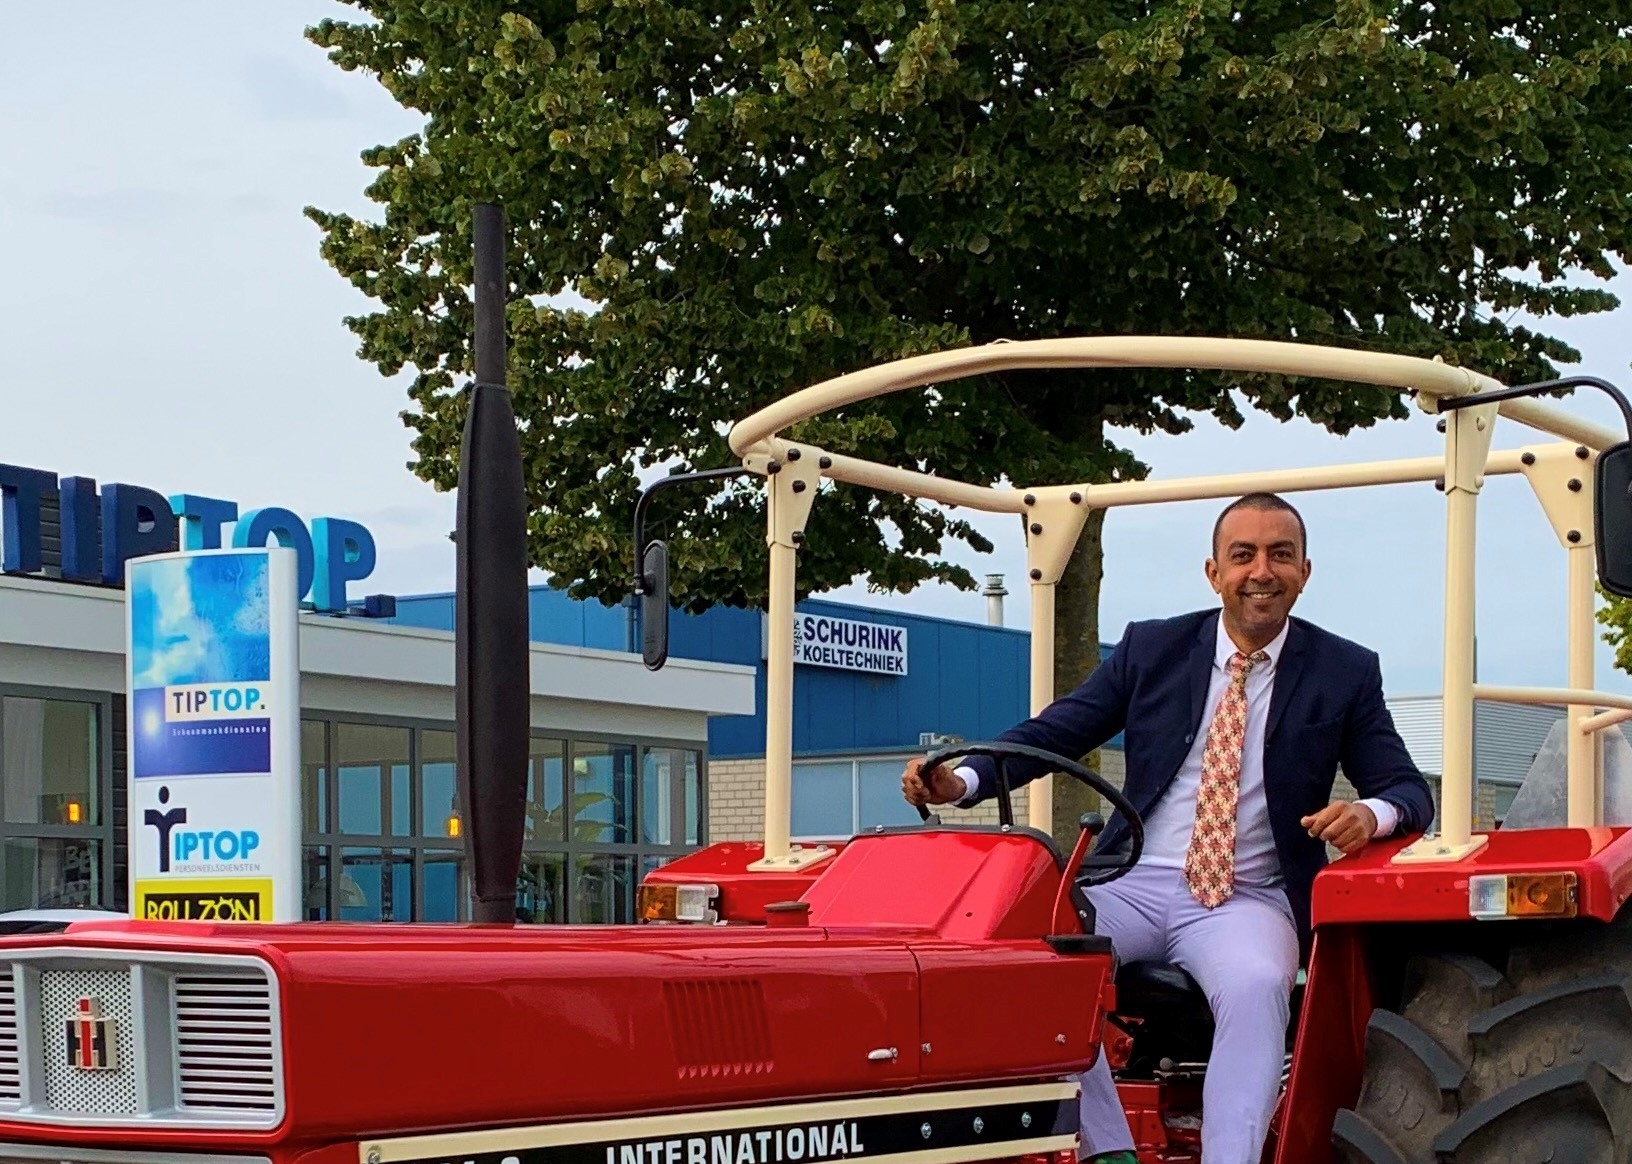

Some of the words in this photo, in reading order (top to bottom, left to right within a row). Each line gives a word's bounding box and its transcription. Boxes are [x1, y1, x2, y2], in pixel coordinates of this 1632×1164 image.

[803, 616, 903, 653] SCHURINK
[803, 643, 904, 673] KOELTECHNIEK
[174, 863, 260, 873] PERSONEELSDIENSTEN
